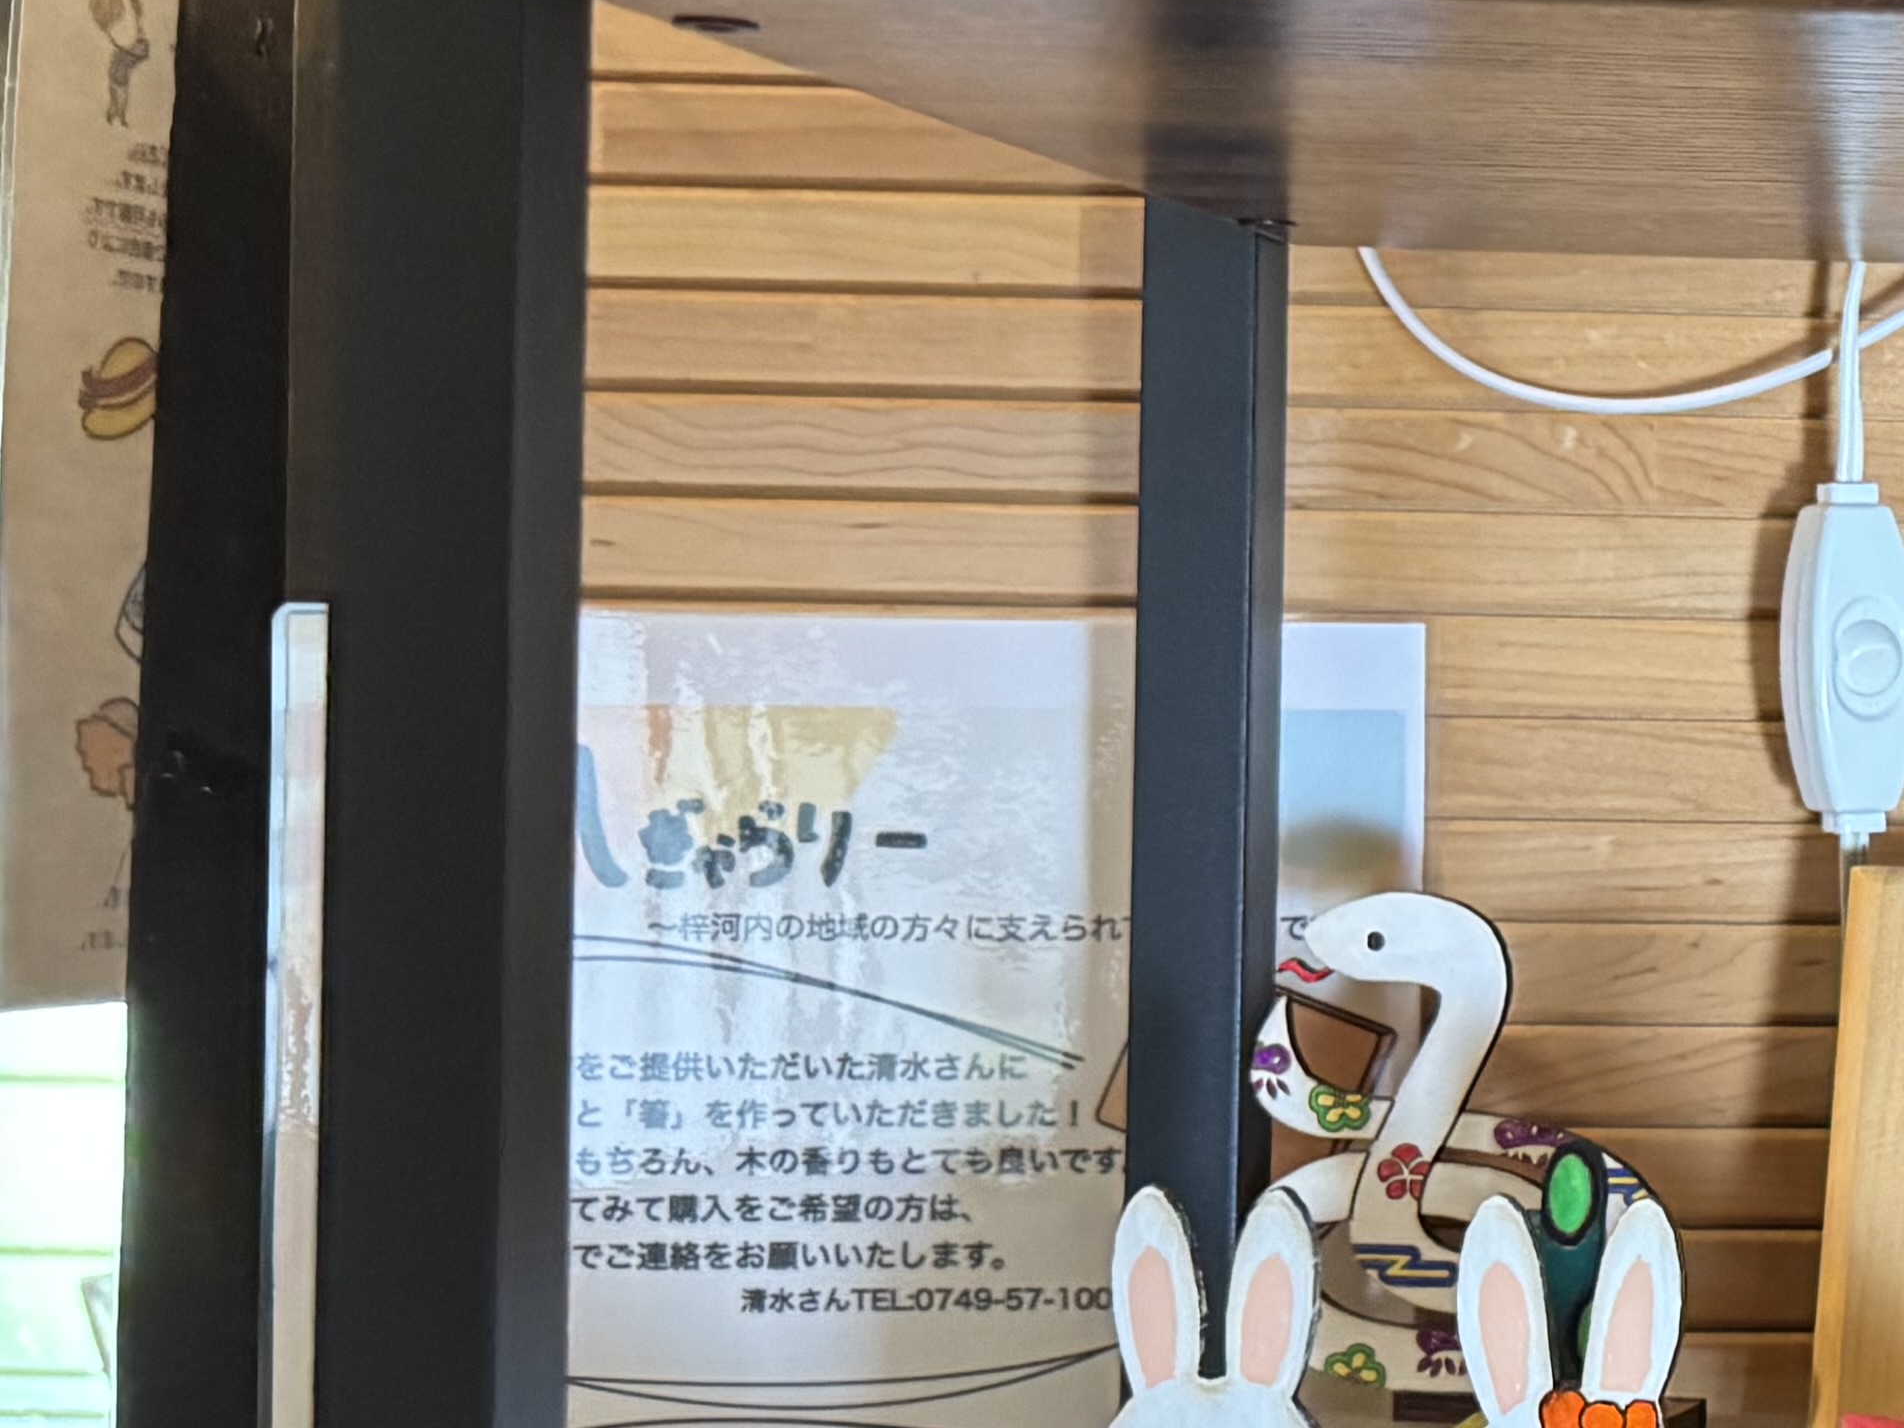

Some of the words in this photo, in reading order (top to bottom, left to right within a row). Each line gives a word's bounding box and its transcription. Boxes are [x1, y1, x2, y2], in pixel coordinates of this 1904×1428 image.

[648, 912, 1131, 942] 〜梓河内の地域の方々に支えられ
[577, 1052, 1028, 1082] をご提供いただいた清水さんに
[576, 1146, 1127, 1175] もちろん、木の香りもとても良いです
[573, 1242, 1004, 1271] でご連絡をお願いいたします。
